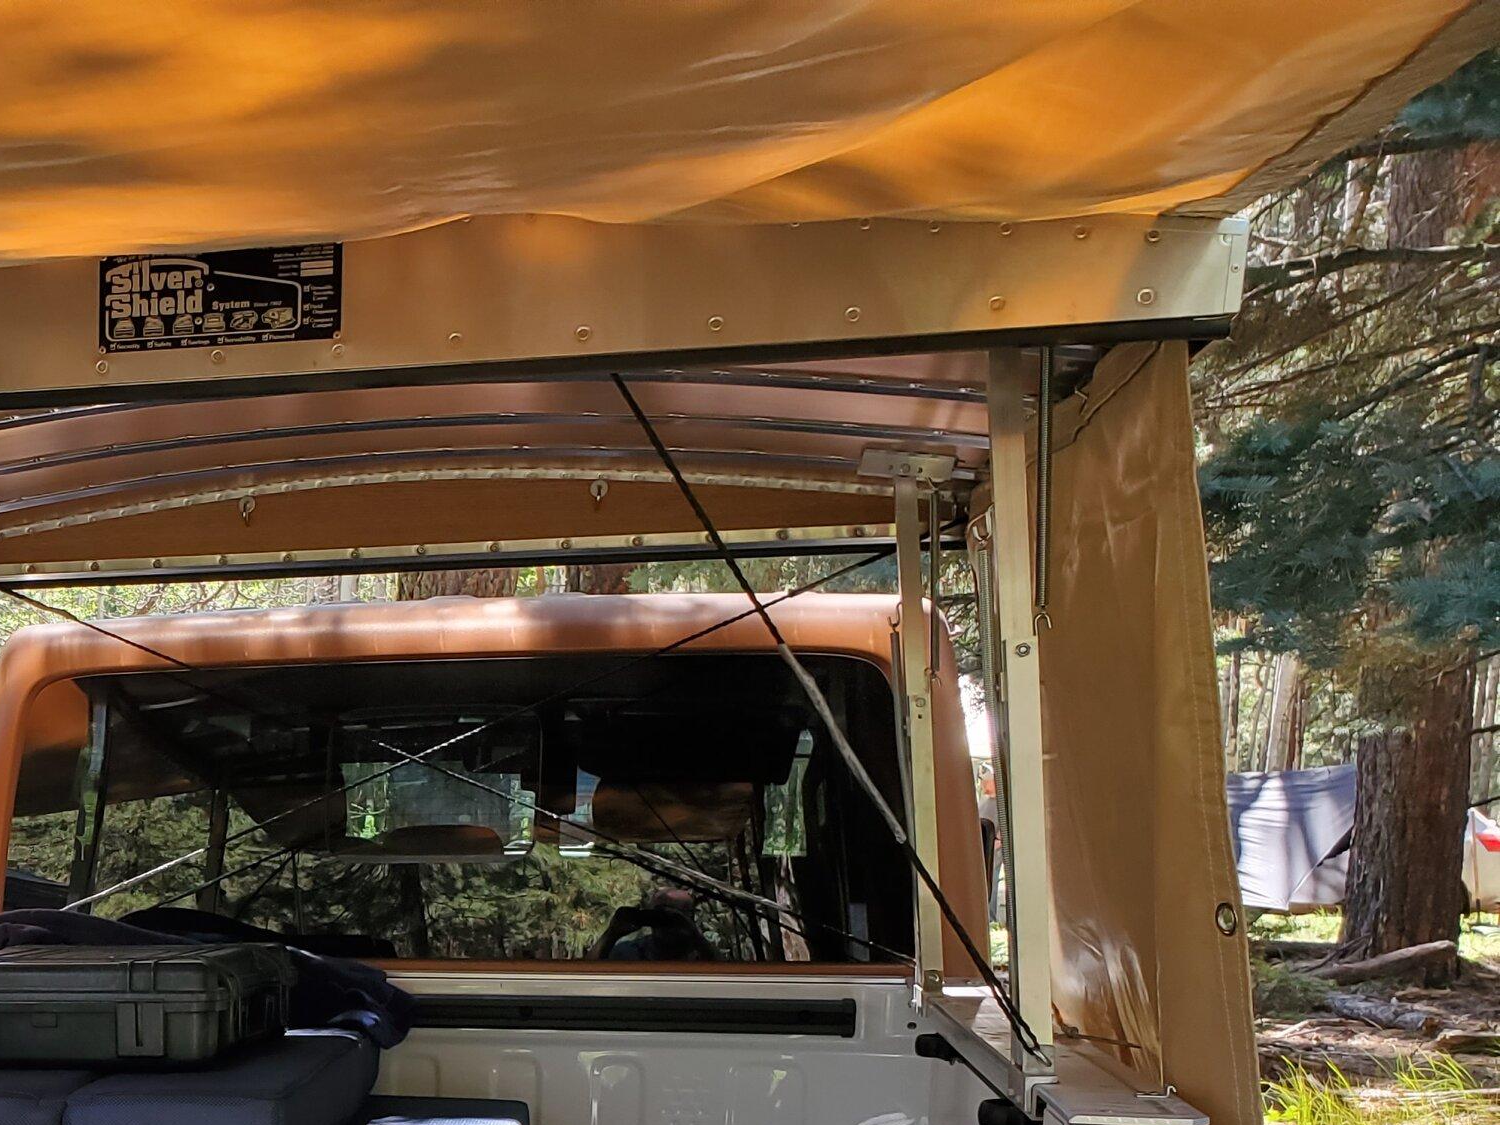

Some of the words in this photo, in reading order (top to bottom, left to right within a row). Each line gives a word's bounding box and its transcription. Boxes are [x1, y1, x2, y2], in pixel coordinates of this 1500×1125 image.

[106, 260, 202, 293] Silver
[106, 289, 203, 319] Shield
[211, 300, 251, 311] System
